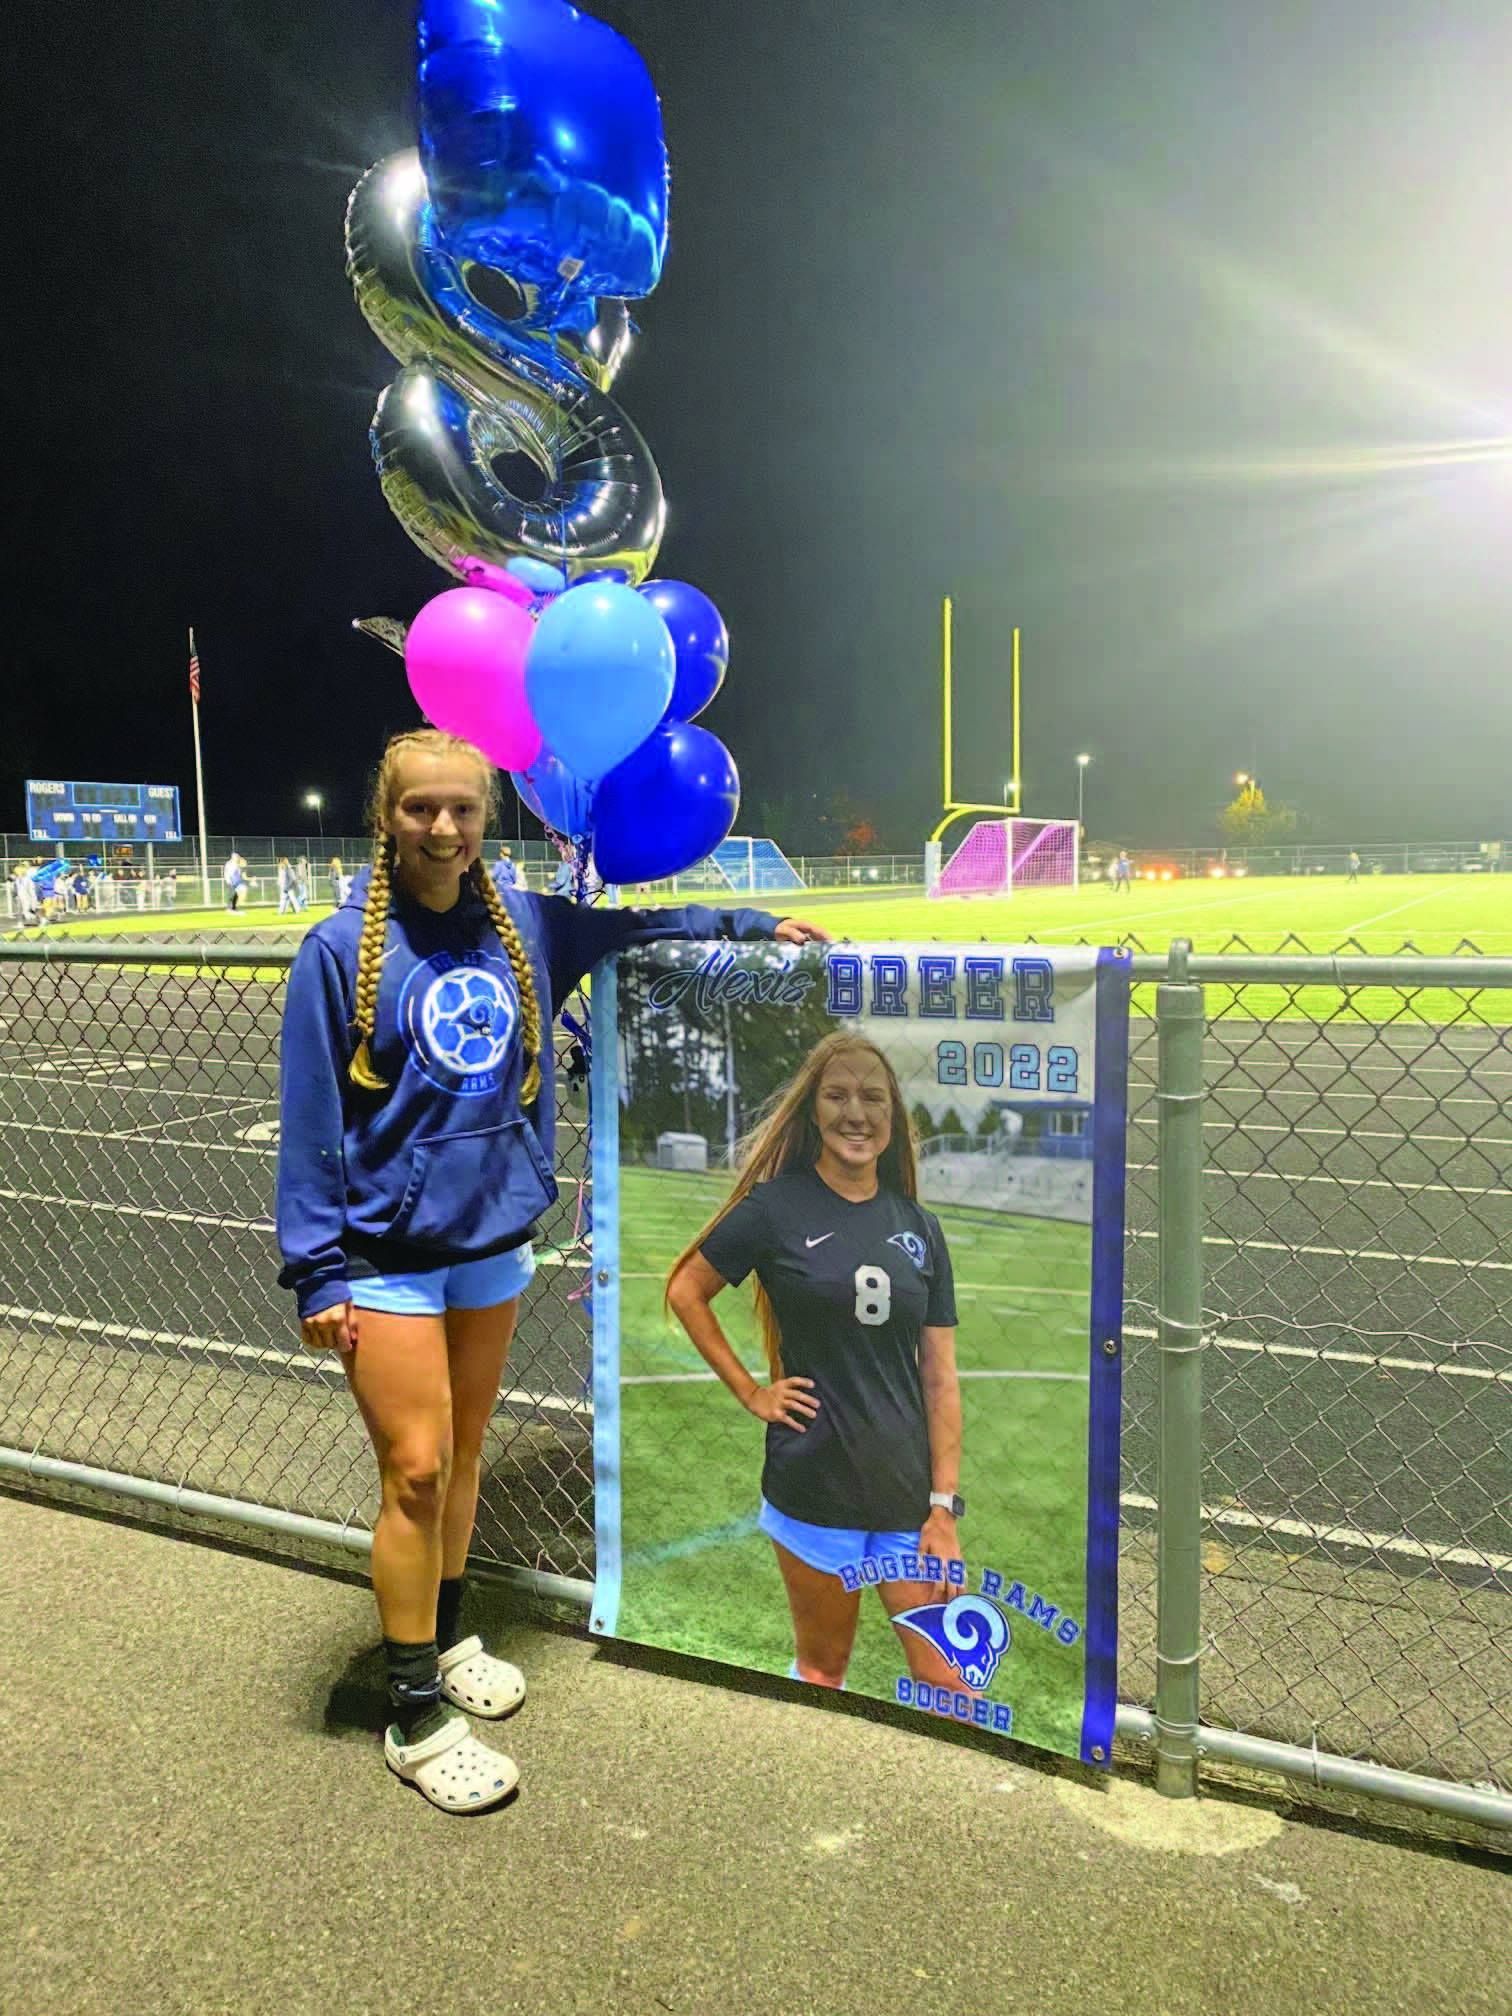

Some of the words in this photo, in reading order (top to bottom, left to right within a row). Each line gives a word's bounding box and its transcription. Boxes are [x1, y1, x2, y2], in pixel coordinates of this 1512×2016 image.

[29, 782, 65, 795] ROGERS
[148, 786, 174, 799] GUEST
[647, 948, 816, 1014] Alexis
[826, 953, 1055, 1022] BREER
[936, 1040, 1079, 1093] 2022
[855, 1265, 891, 1326] 8
[838, 1553, 966, 1593] ROGERS
[980, 1567, 1081, 1647] RAMS
[896, 1676, 1013, 1734] SOCCER
